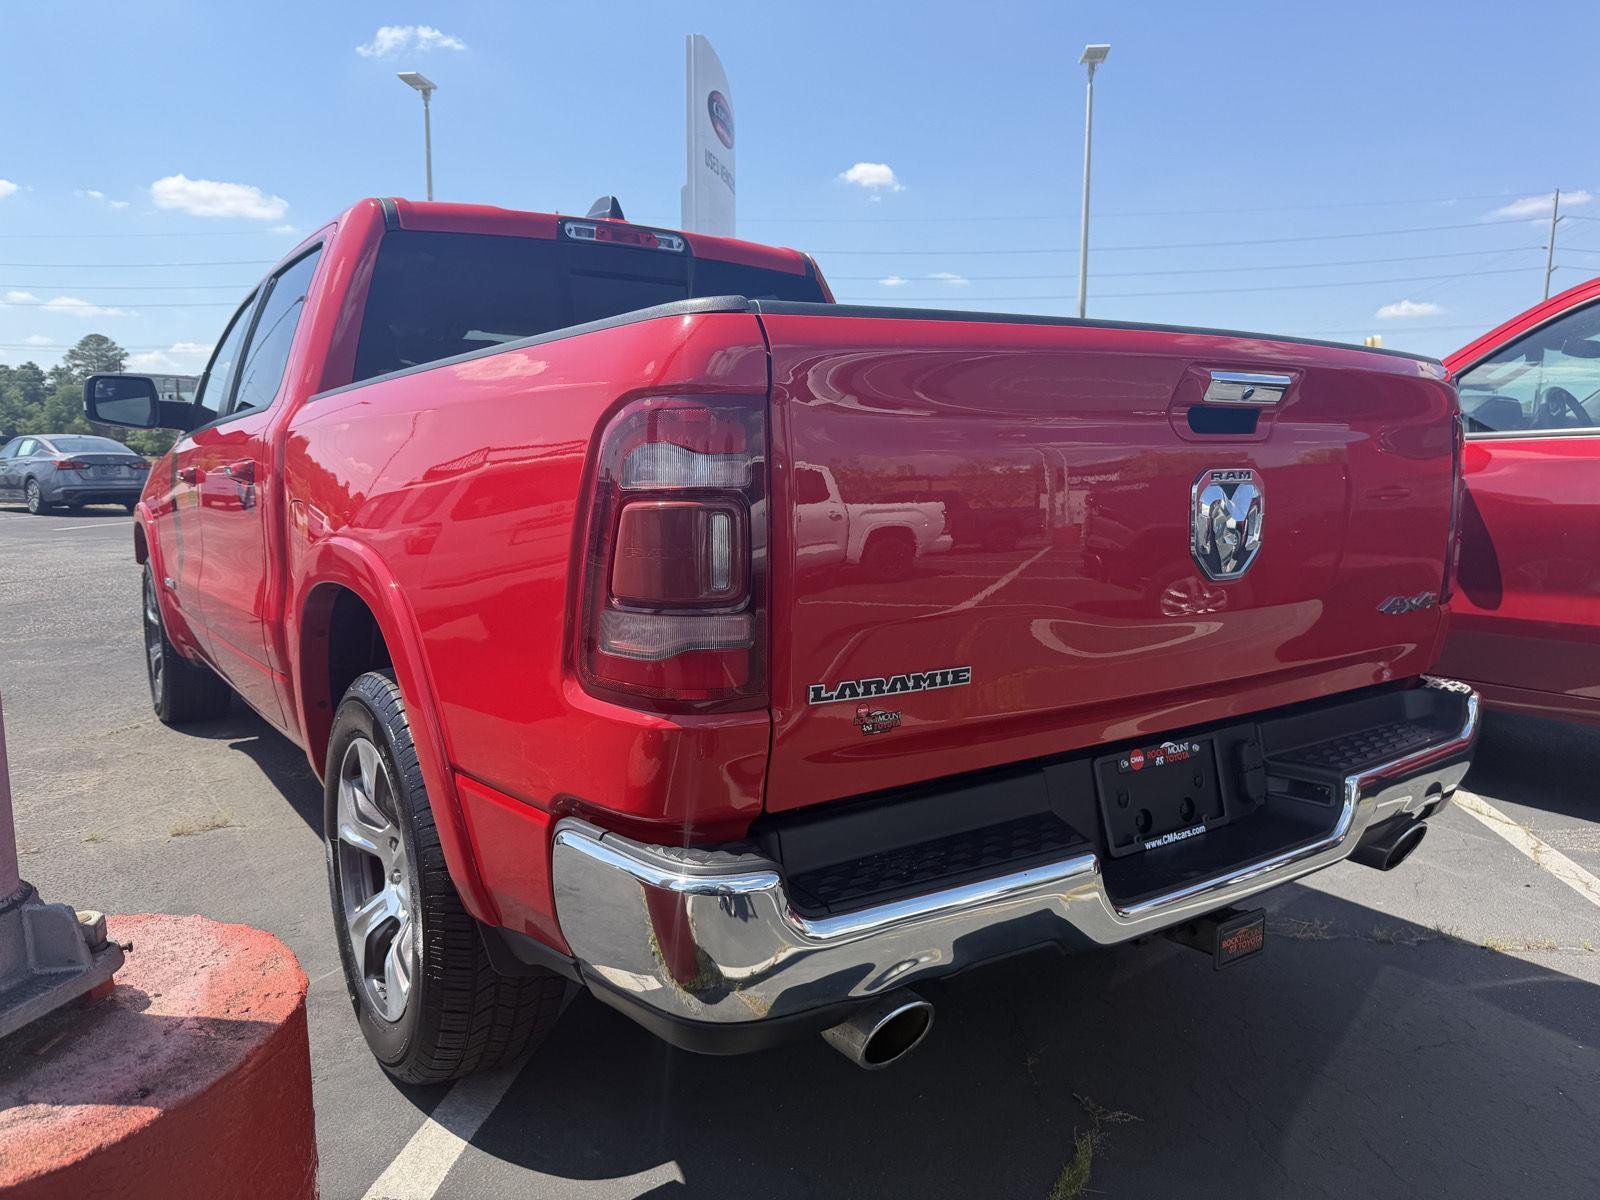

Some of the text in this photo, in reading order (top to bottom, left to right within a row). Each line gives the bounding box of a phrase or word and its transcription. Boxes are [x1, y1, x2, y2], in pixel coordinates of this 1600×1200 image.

[1211, 470, 1252, 480] RAM
[808, 666, 972, 705] LARAMIE
[1168, 742, 1189, 755] MOUNT
[1167, 751, 1190, 762] TOYOTA
[1144, 825, 1206, 850] www.CMAcars.com
